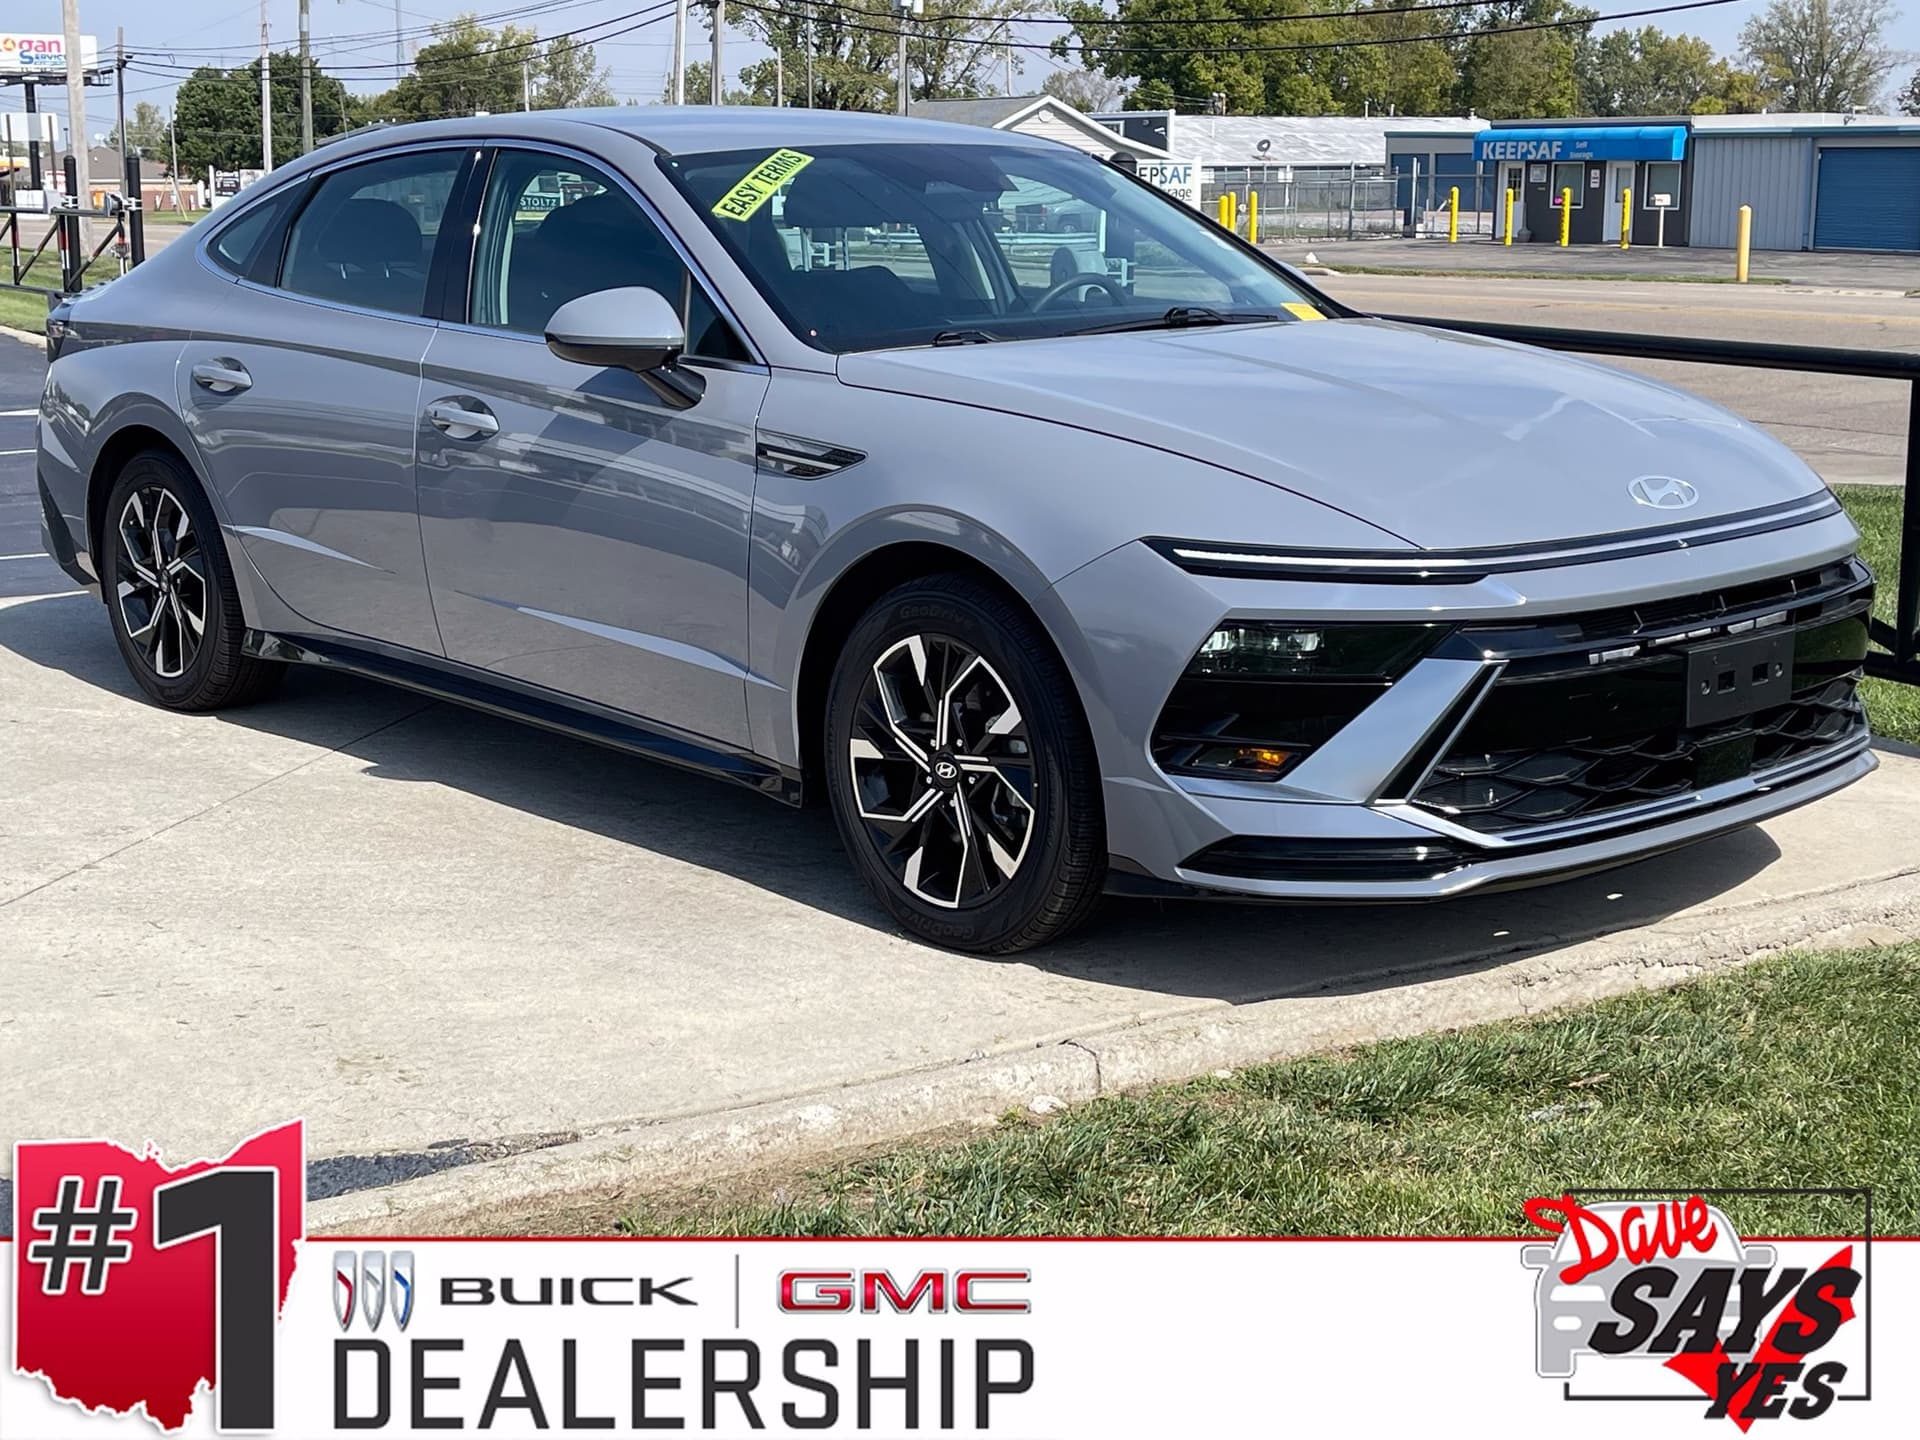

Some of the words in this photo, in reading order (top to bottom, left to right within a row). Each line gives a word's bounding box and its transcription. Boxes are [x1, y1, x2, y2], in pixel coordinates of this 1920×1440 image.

[1482, 141, 1562, 160] KEEPSAF
[1139, 166, 1192, 184] EPSAF
[720, 182, 763, 217] EASY
[752, 152, 802, 186] TERMS
[520, 197, 557, 206] STOLTZ
[1167, 188, 1192, 201] rage
